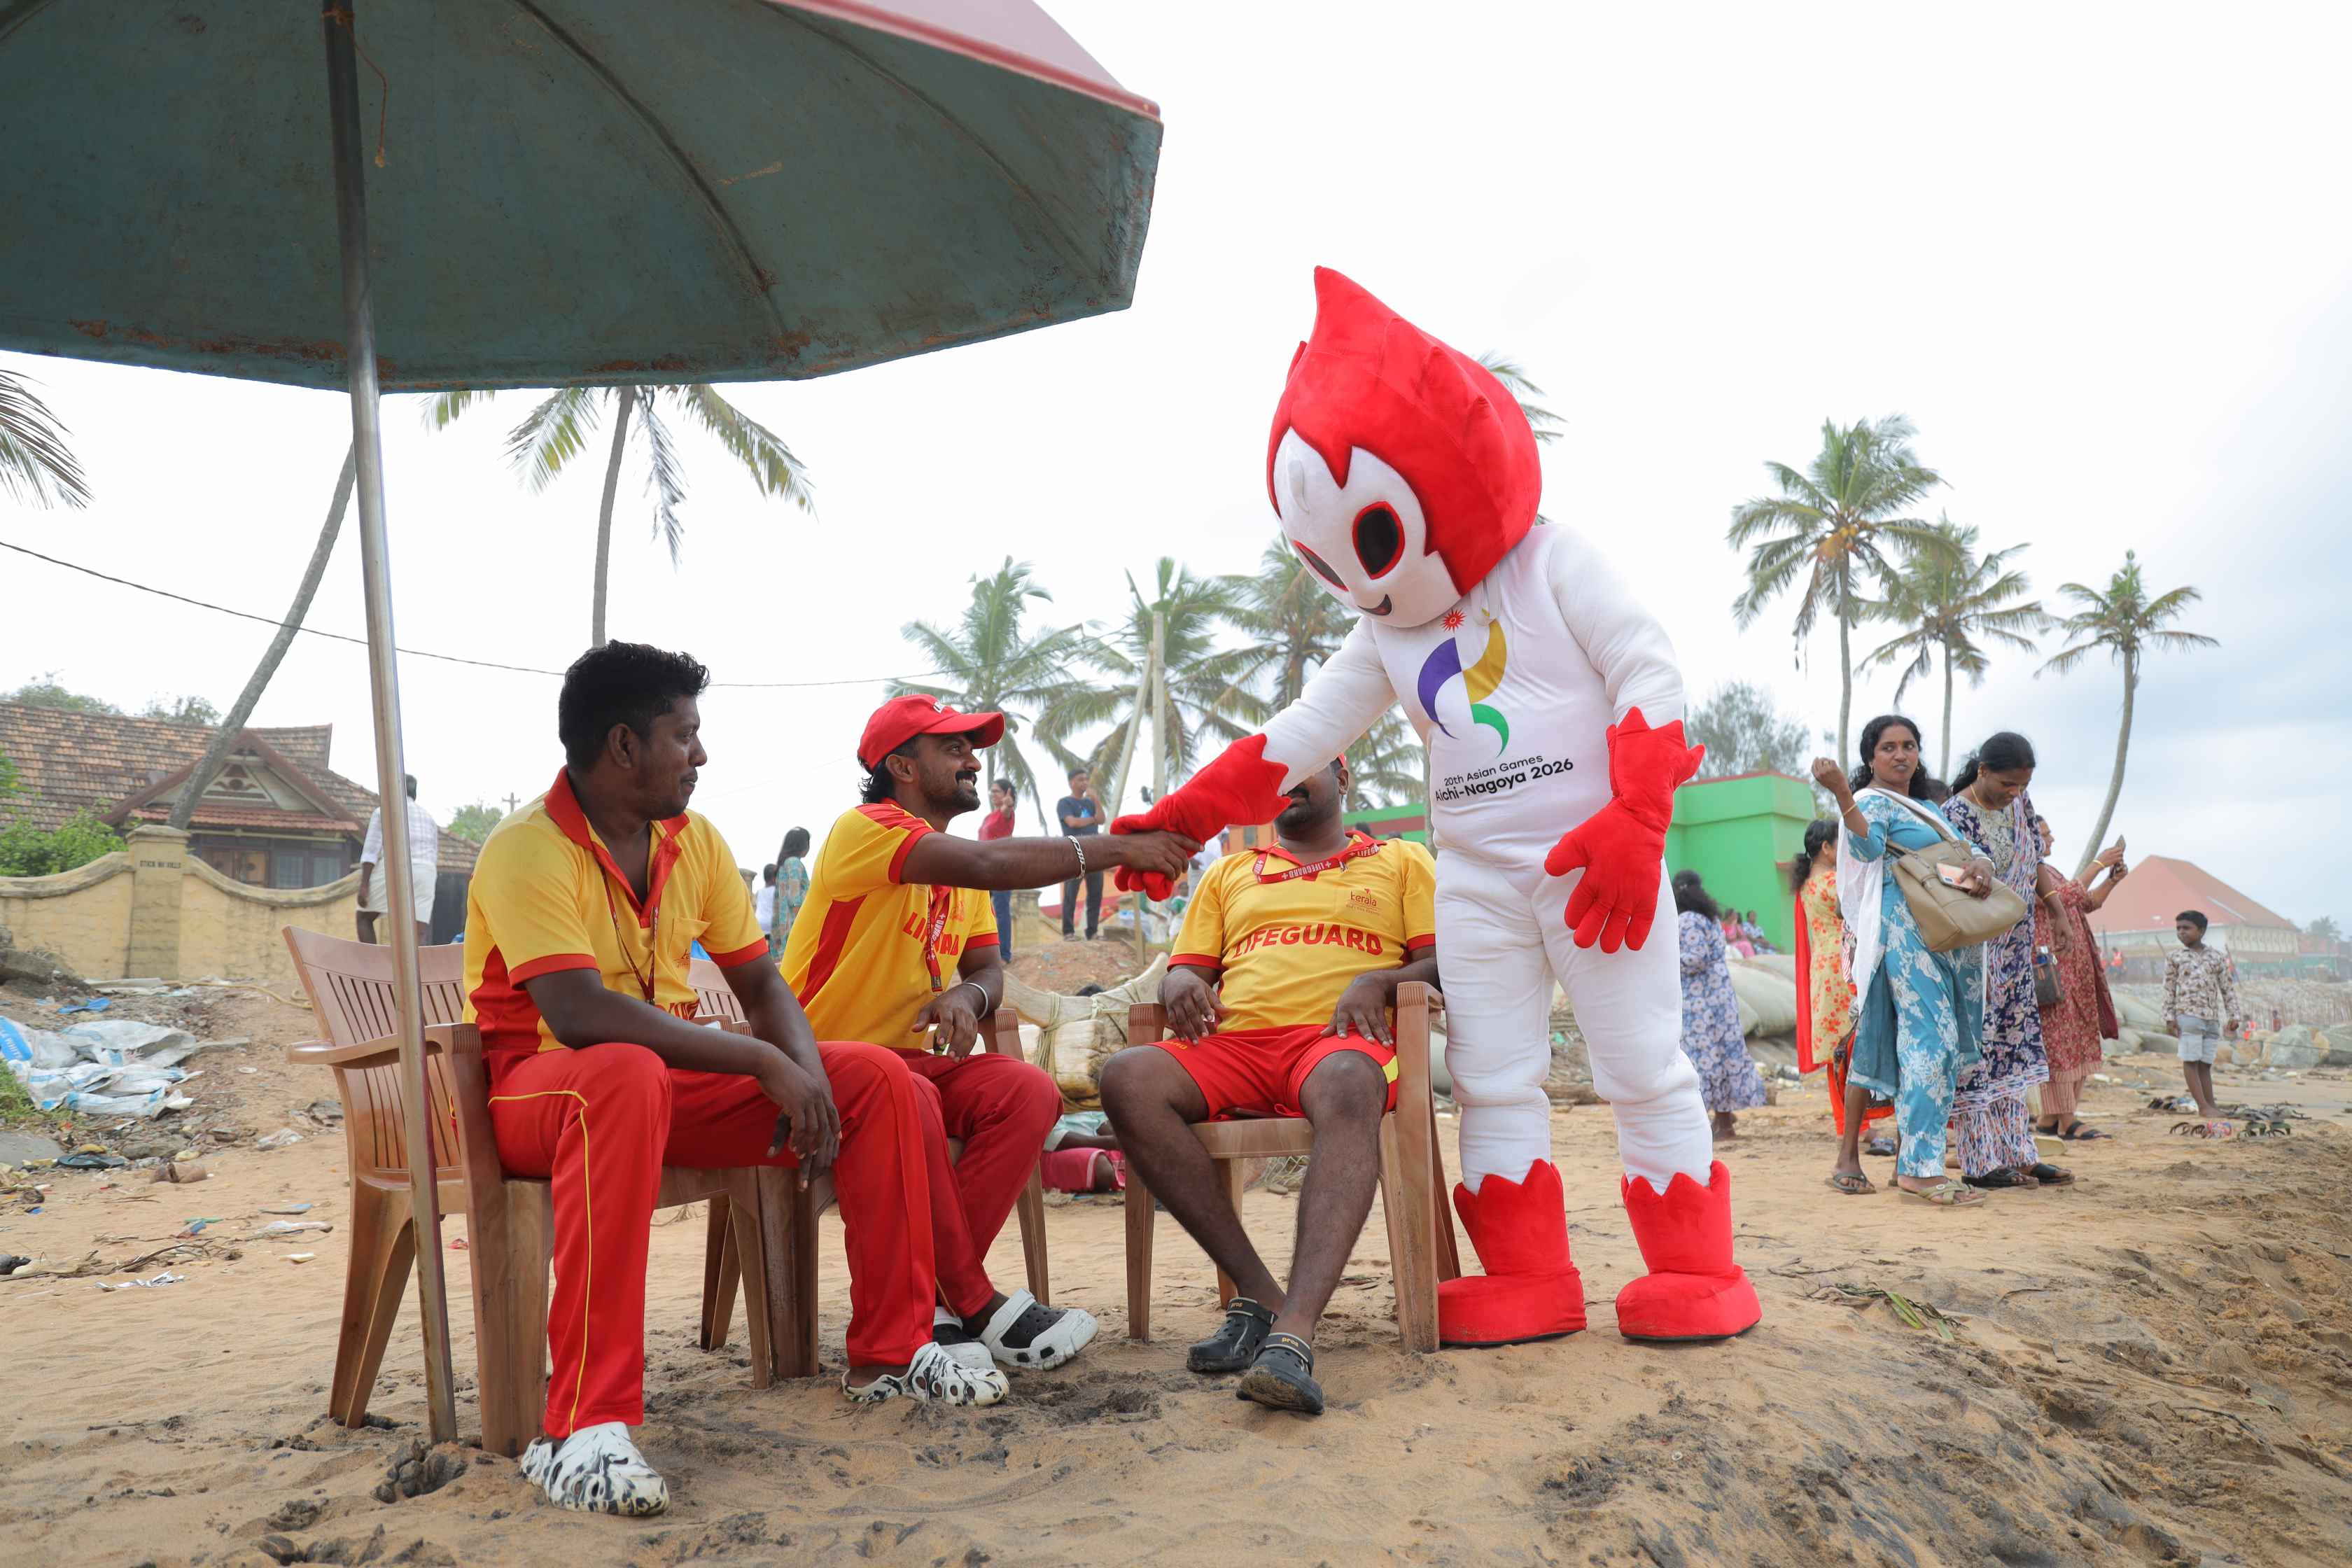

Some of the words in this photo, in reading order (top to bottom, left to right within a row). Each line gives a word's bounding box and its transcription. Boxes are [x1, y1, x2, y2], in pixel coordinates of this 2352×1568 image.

[1435, 772, 1527, 802] Aichi-Nagoya
[1530, 758, 1574, 779] 2026
[1444, 775, 1464, 786] 20th
[1466, 766, 1497, 781] Asian
[1499, 755, 1544, 772] Games
[1288, 862, 1324, 879] LIFEGUARD
[1232, 923, 1383, 959] LIFEGUARD
